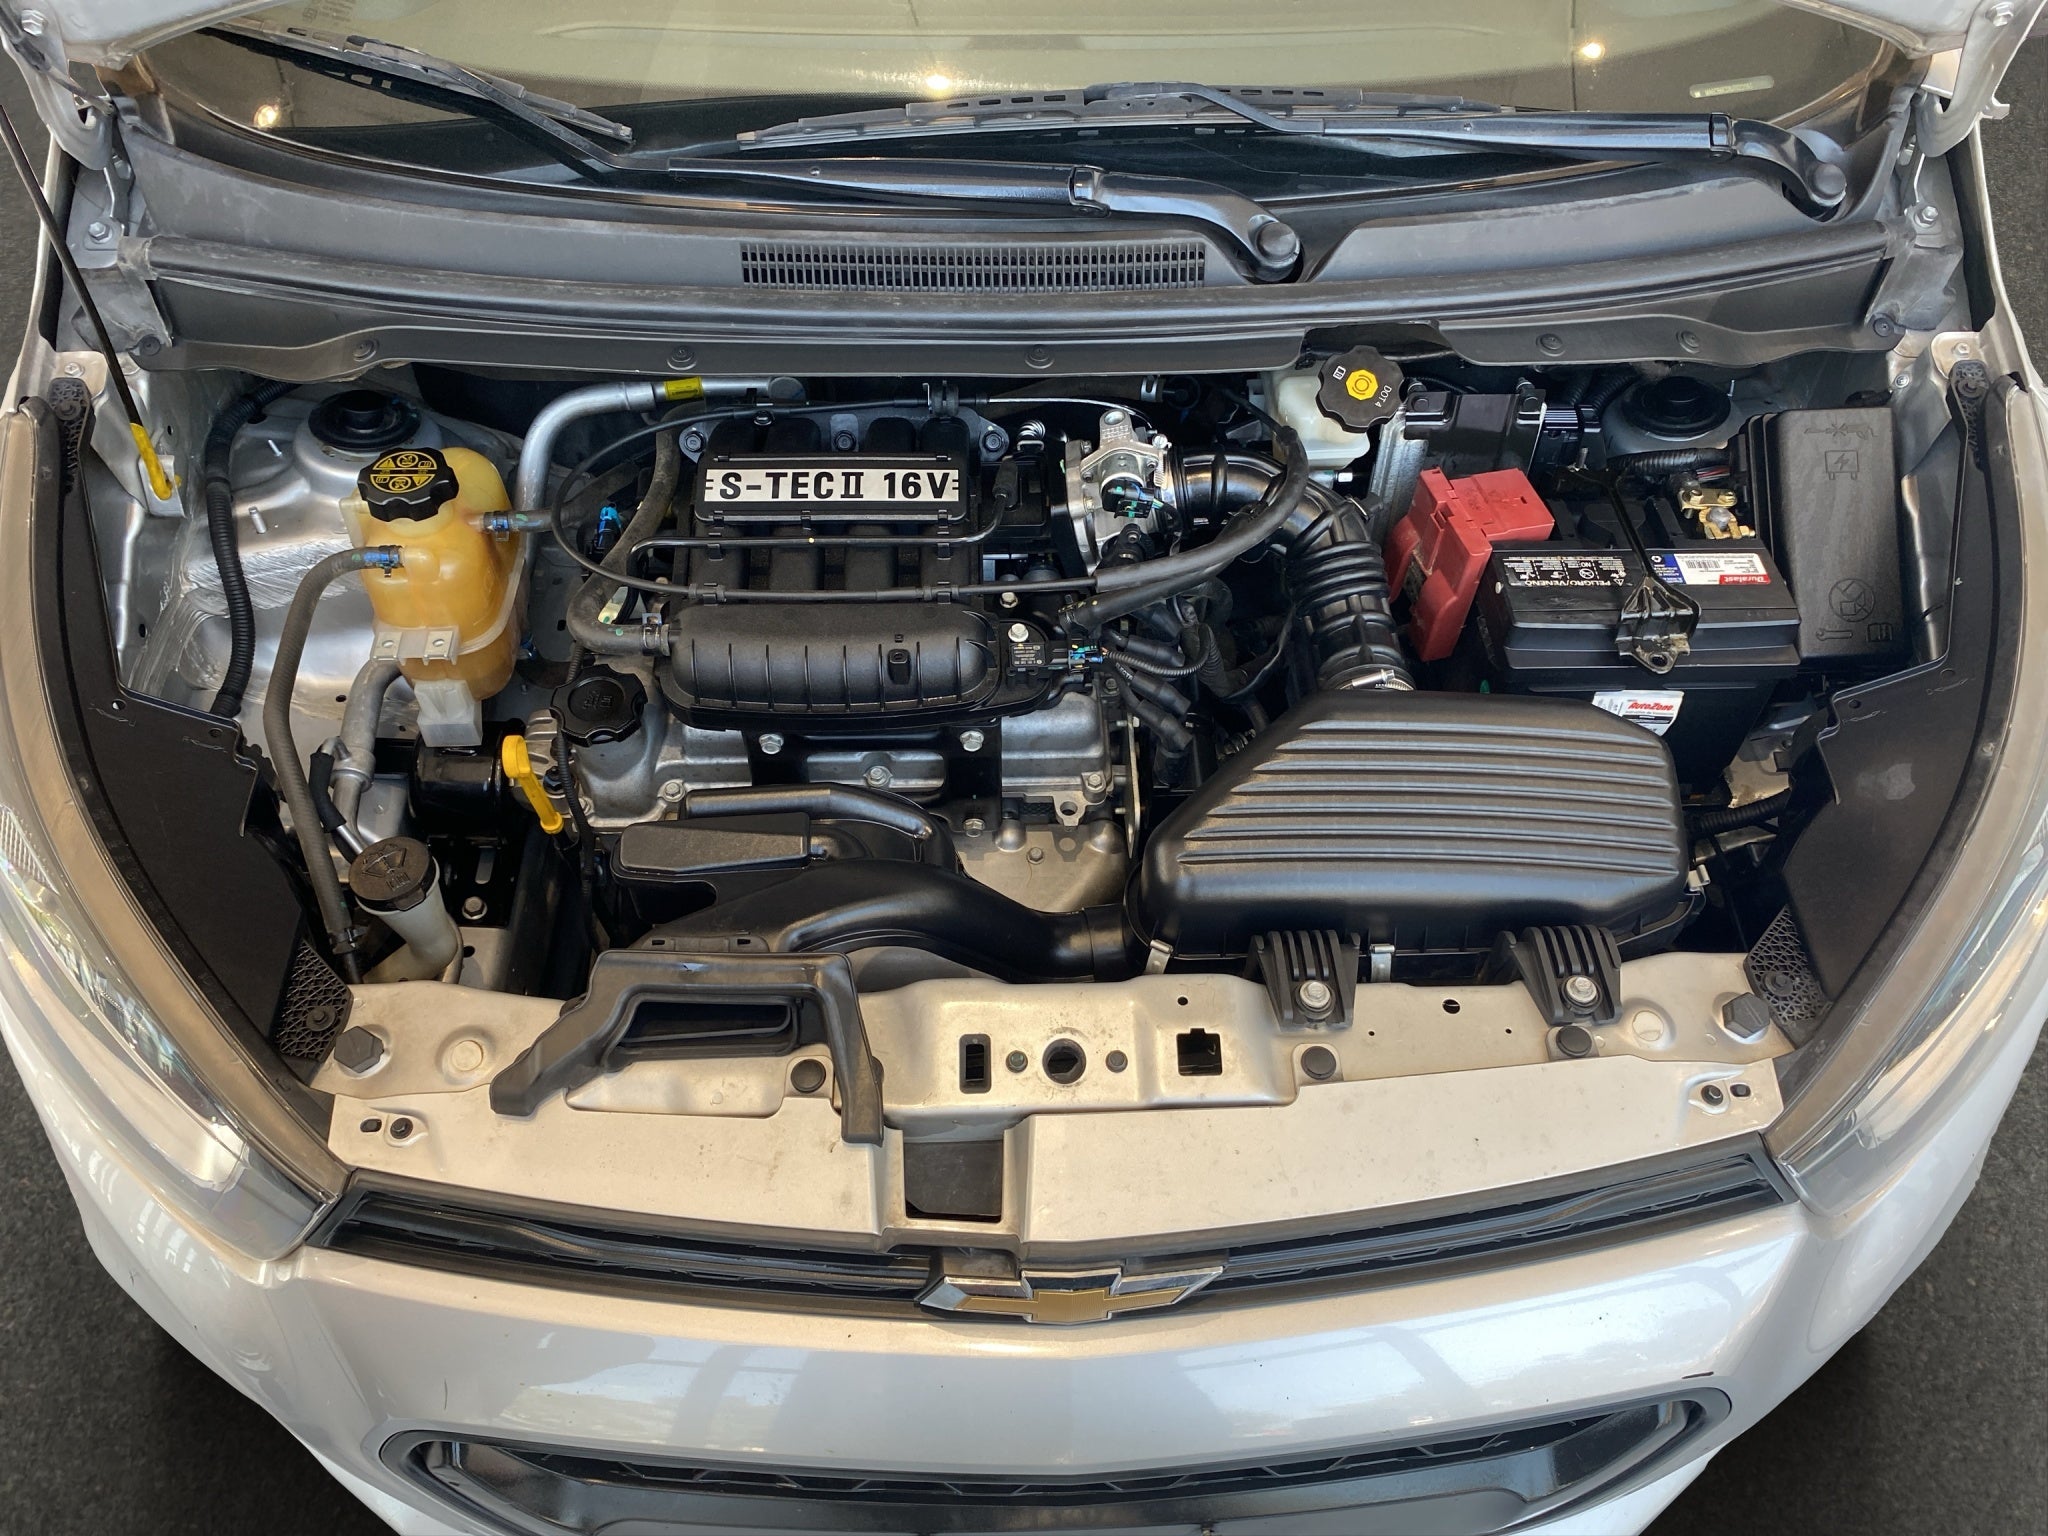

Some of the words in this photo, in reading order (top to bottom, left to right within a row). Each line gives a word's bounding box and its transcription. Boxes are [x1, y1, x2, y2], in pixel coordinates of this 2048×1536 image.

[1379, 385, 1392, 402] DOT
[883, 471, 950, 499] 16V
[1724, 575, 1766, 583] Duralast
[1628, 702, 1674, 711] AutoZone
